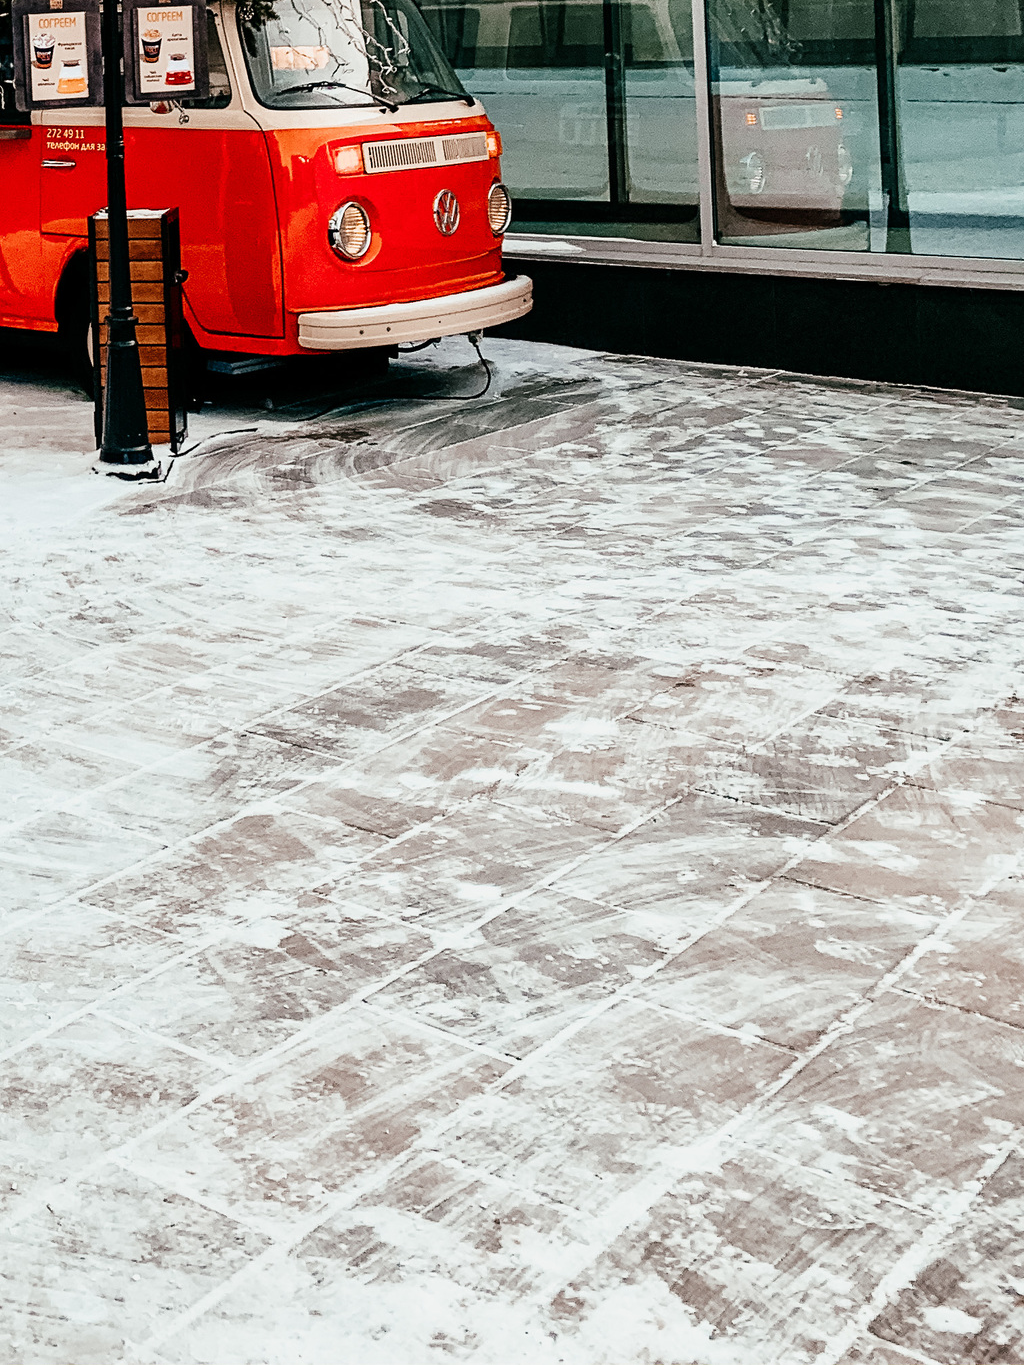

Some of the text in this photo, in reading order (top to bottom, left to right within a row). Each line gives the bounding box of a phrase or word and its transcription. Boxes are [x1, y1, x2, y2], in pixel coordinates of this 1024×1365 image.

[146, 11, 183, 22] СОГРЕЕМ
[38, 17, 77, 29] СОГРЕЕМ
[47, 128, 85, 139] 272 49 11
[46, 141, 80, 151] телефон
[81, 143, 95, 151] для
[434, 191, 458, 233] VW
